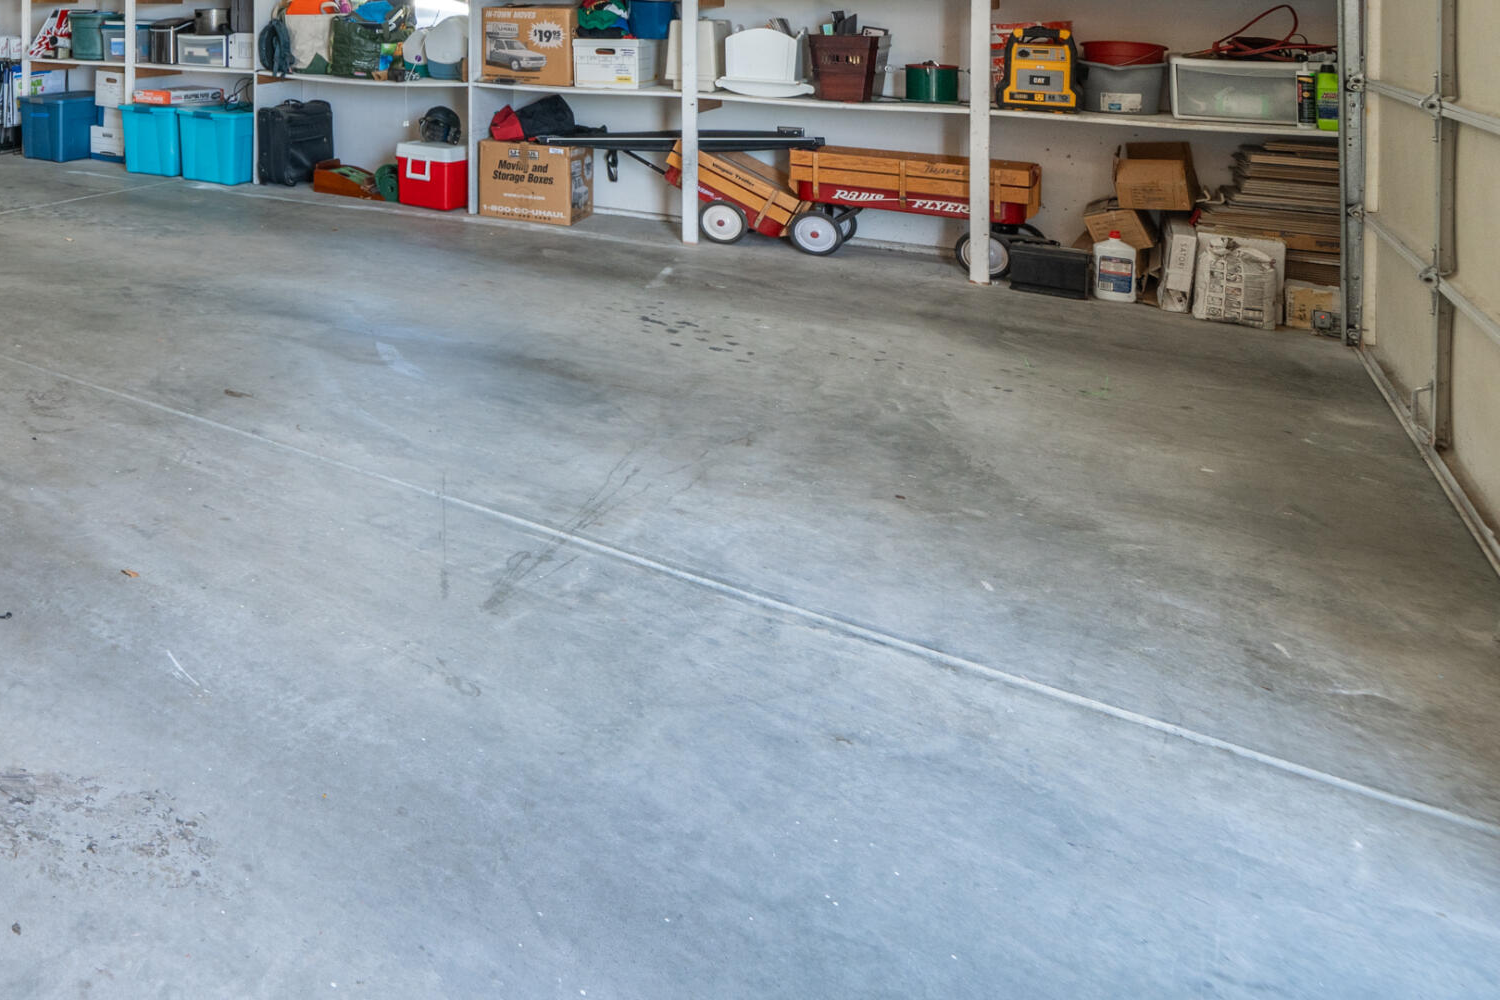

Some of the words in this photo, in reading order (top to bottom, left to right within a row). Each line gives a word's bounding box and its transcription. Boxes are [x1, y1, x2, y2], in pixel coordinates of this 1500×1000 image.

[497, 160, 529, 174] Moving
[531, 163, 549, 174] and
[492, 170, 526, 184] Storage
[527, 173, 554, 185] Boxes
[832, 188, 885, 201] RADIO
[912, 199, 970, 214] FLYER
